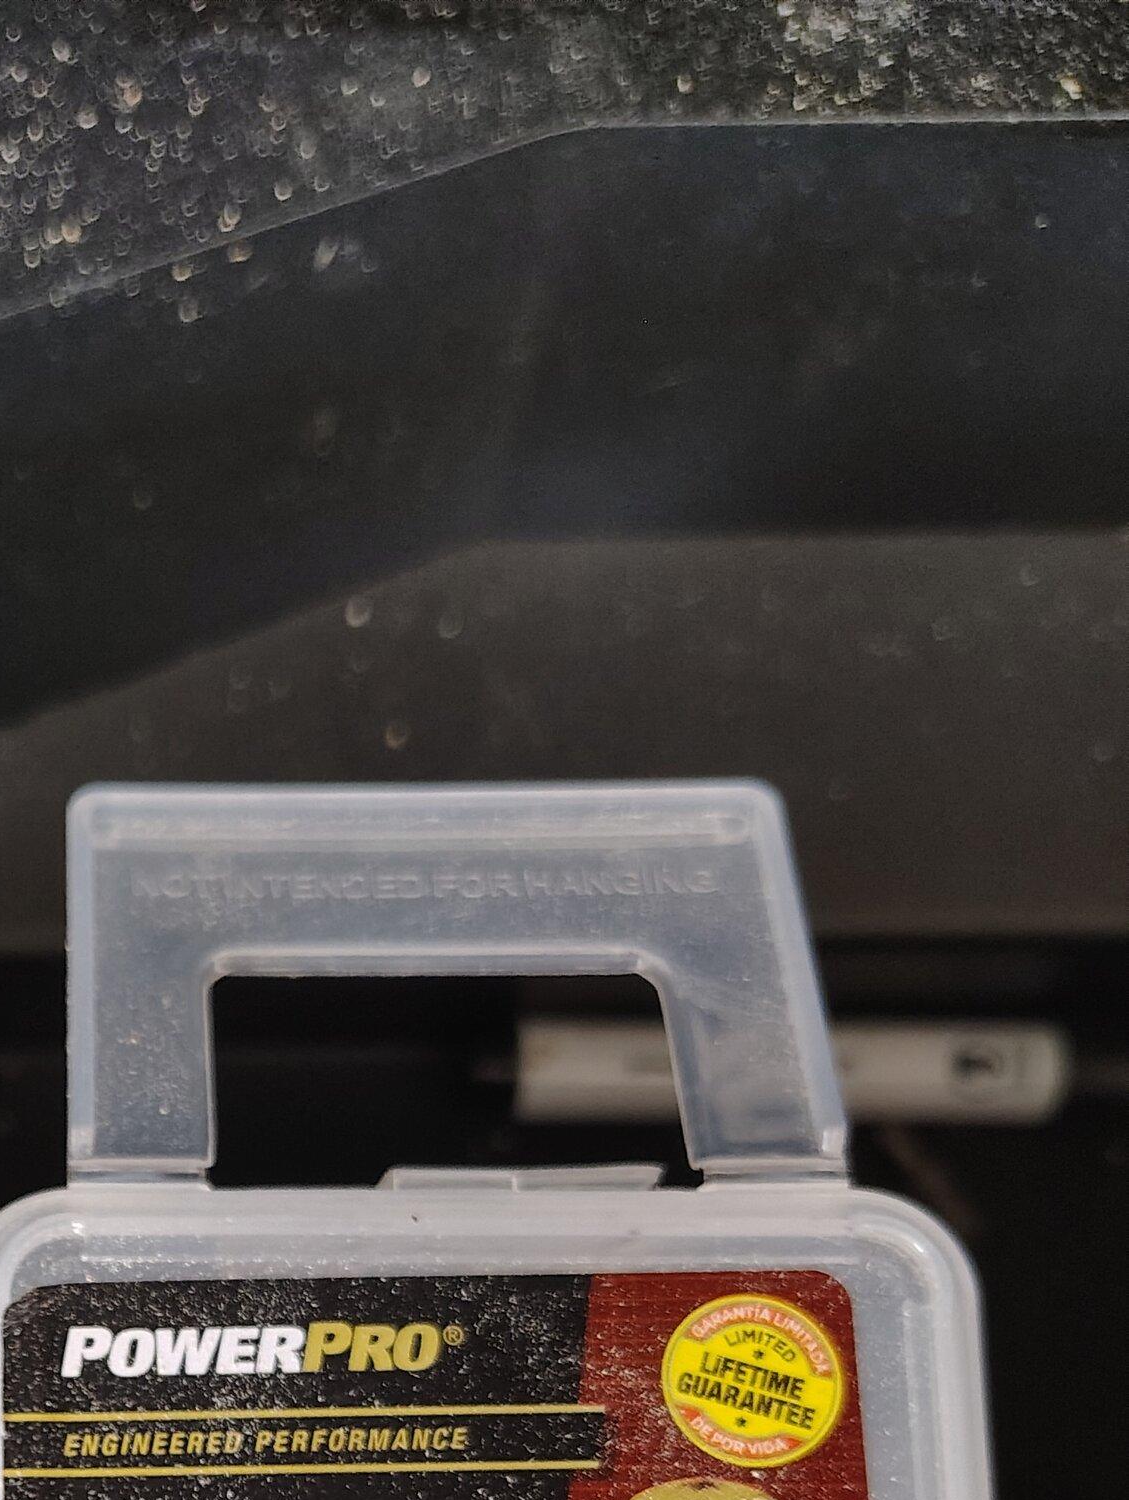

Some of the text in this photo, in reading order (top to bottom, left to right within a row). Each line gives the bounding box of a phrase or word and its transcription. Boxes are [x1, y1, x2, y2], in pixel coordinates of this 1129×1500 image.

[723, 1328, 797, 1363] LIMITED
[698, 1351, 806, 1400] LIFETIME
[676, 1371, 816, 1430] GUARANTEE
[64, 1426, 469, 1456] ENGINEERED PERFORMANCE
